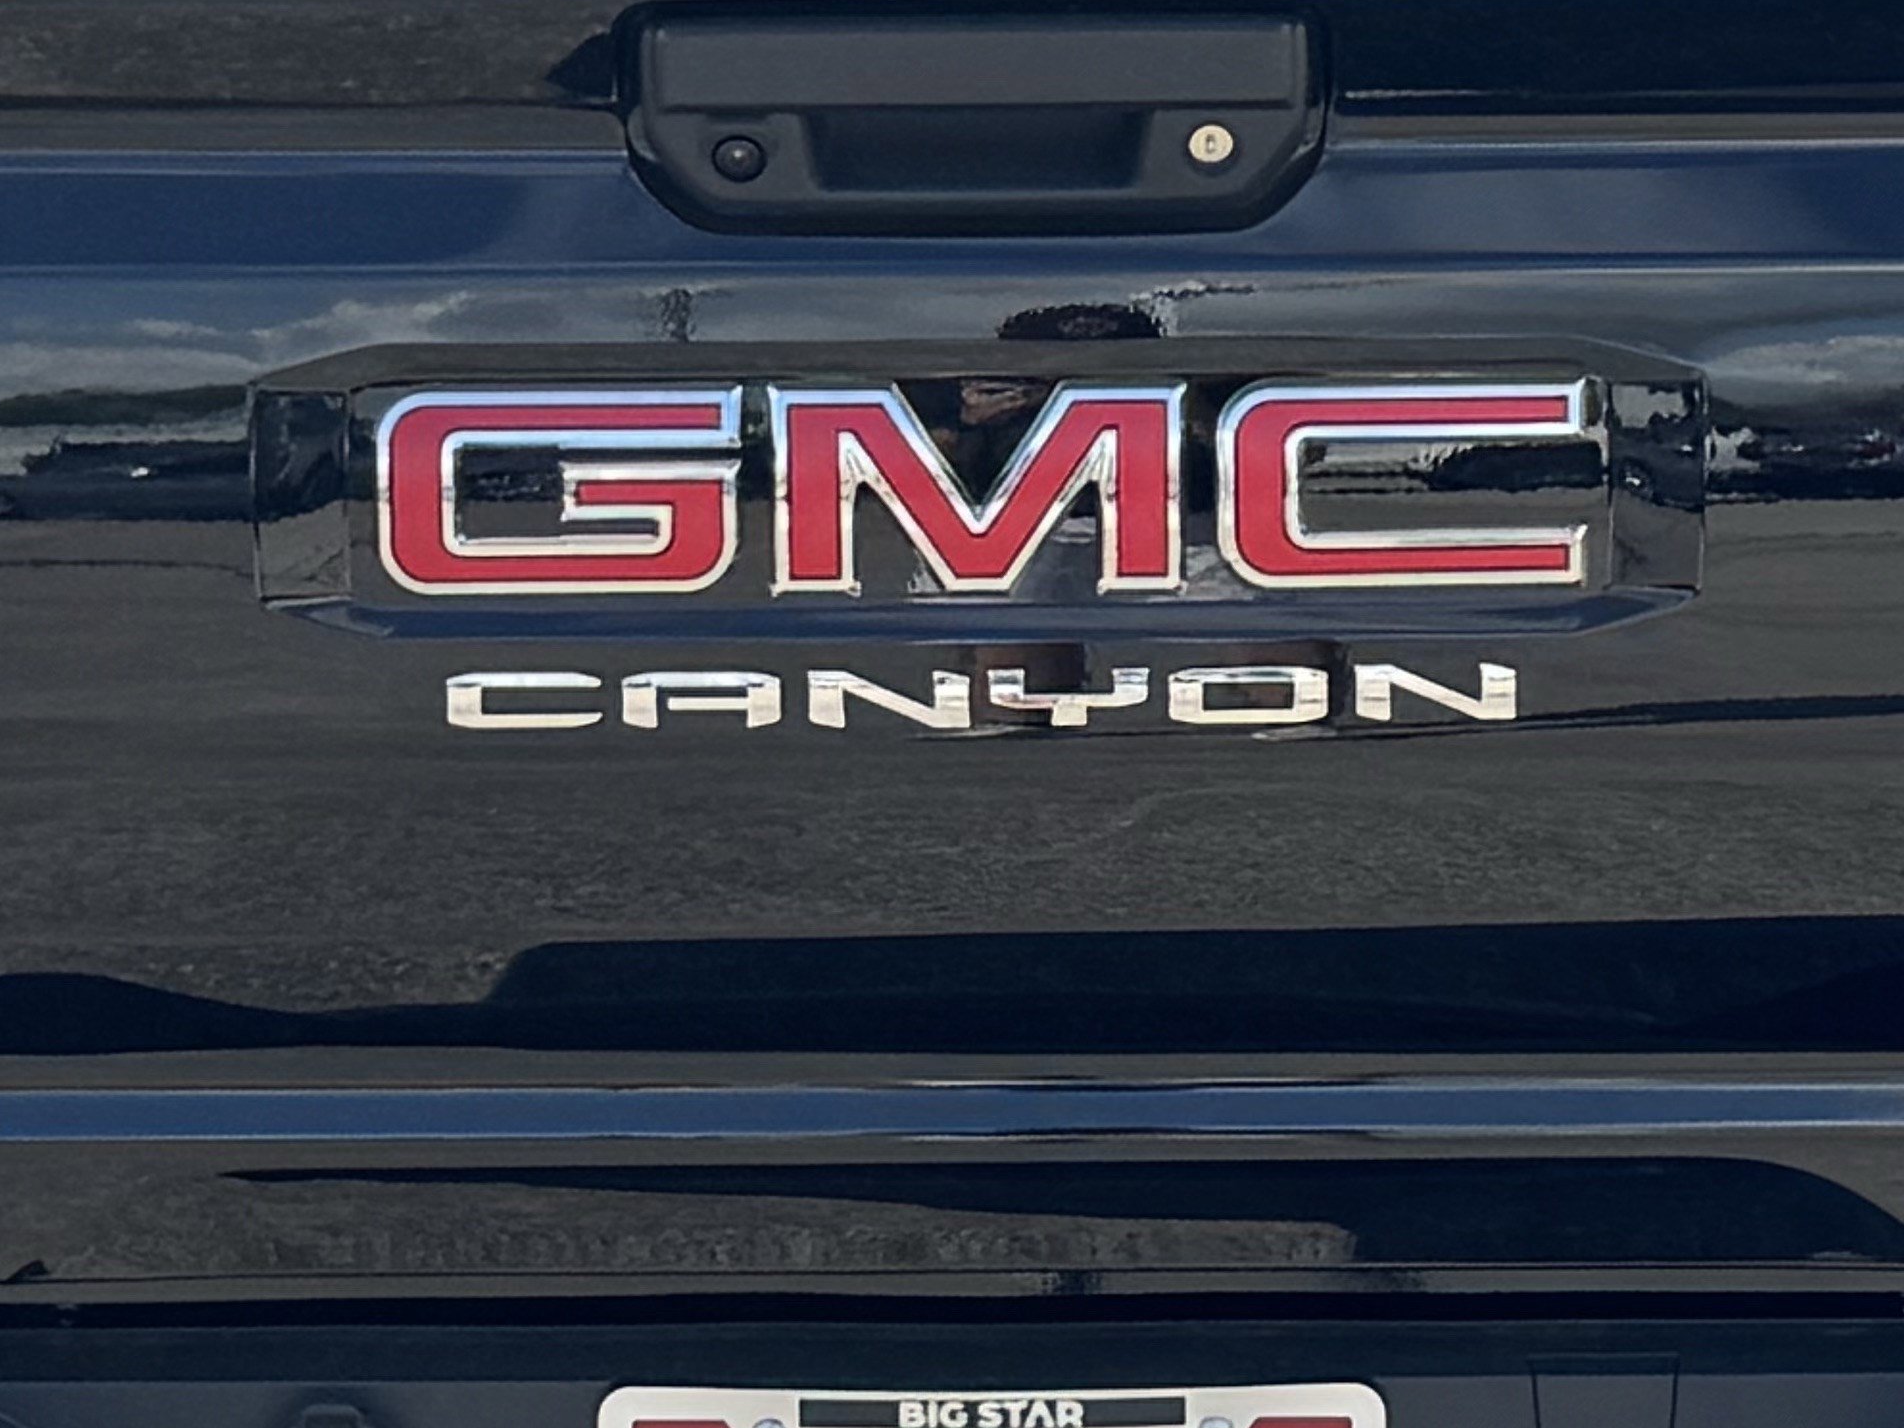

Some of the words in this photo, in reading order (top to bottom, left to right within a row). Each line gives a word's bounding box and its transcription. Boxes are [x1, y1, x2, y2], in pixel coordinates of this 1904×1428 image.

[376, 382, 1590, 598] GMC
[444, 662, 1518, 730] CANYON
[898, 1400, 969, 1428] BIG
[976, 1398, 1084, 1428] STAR
